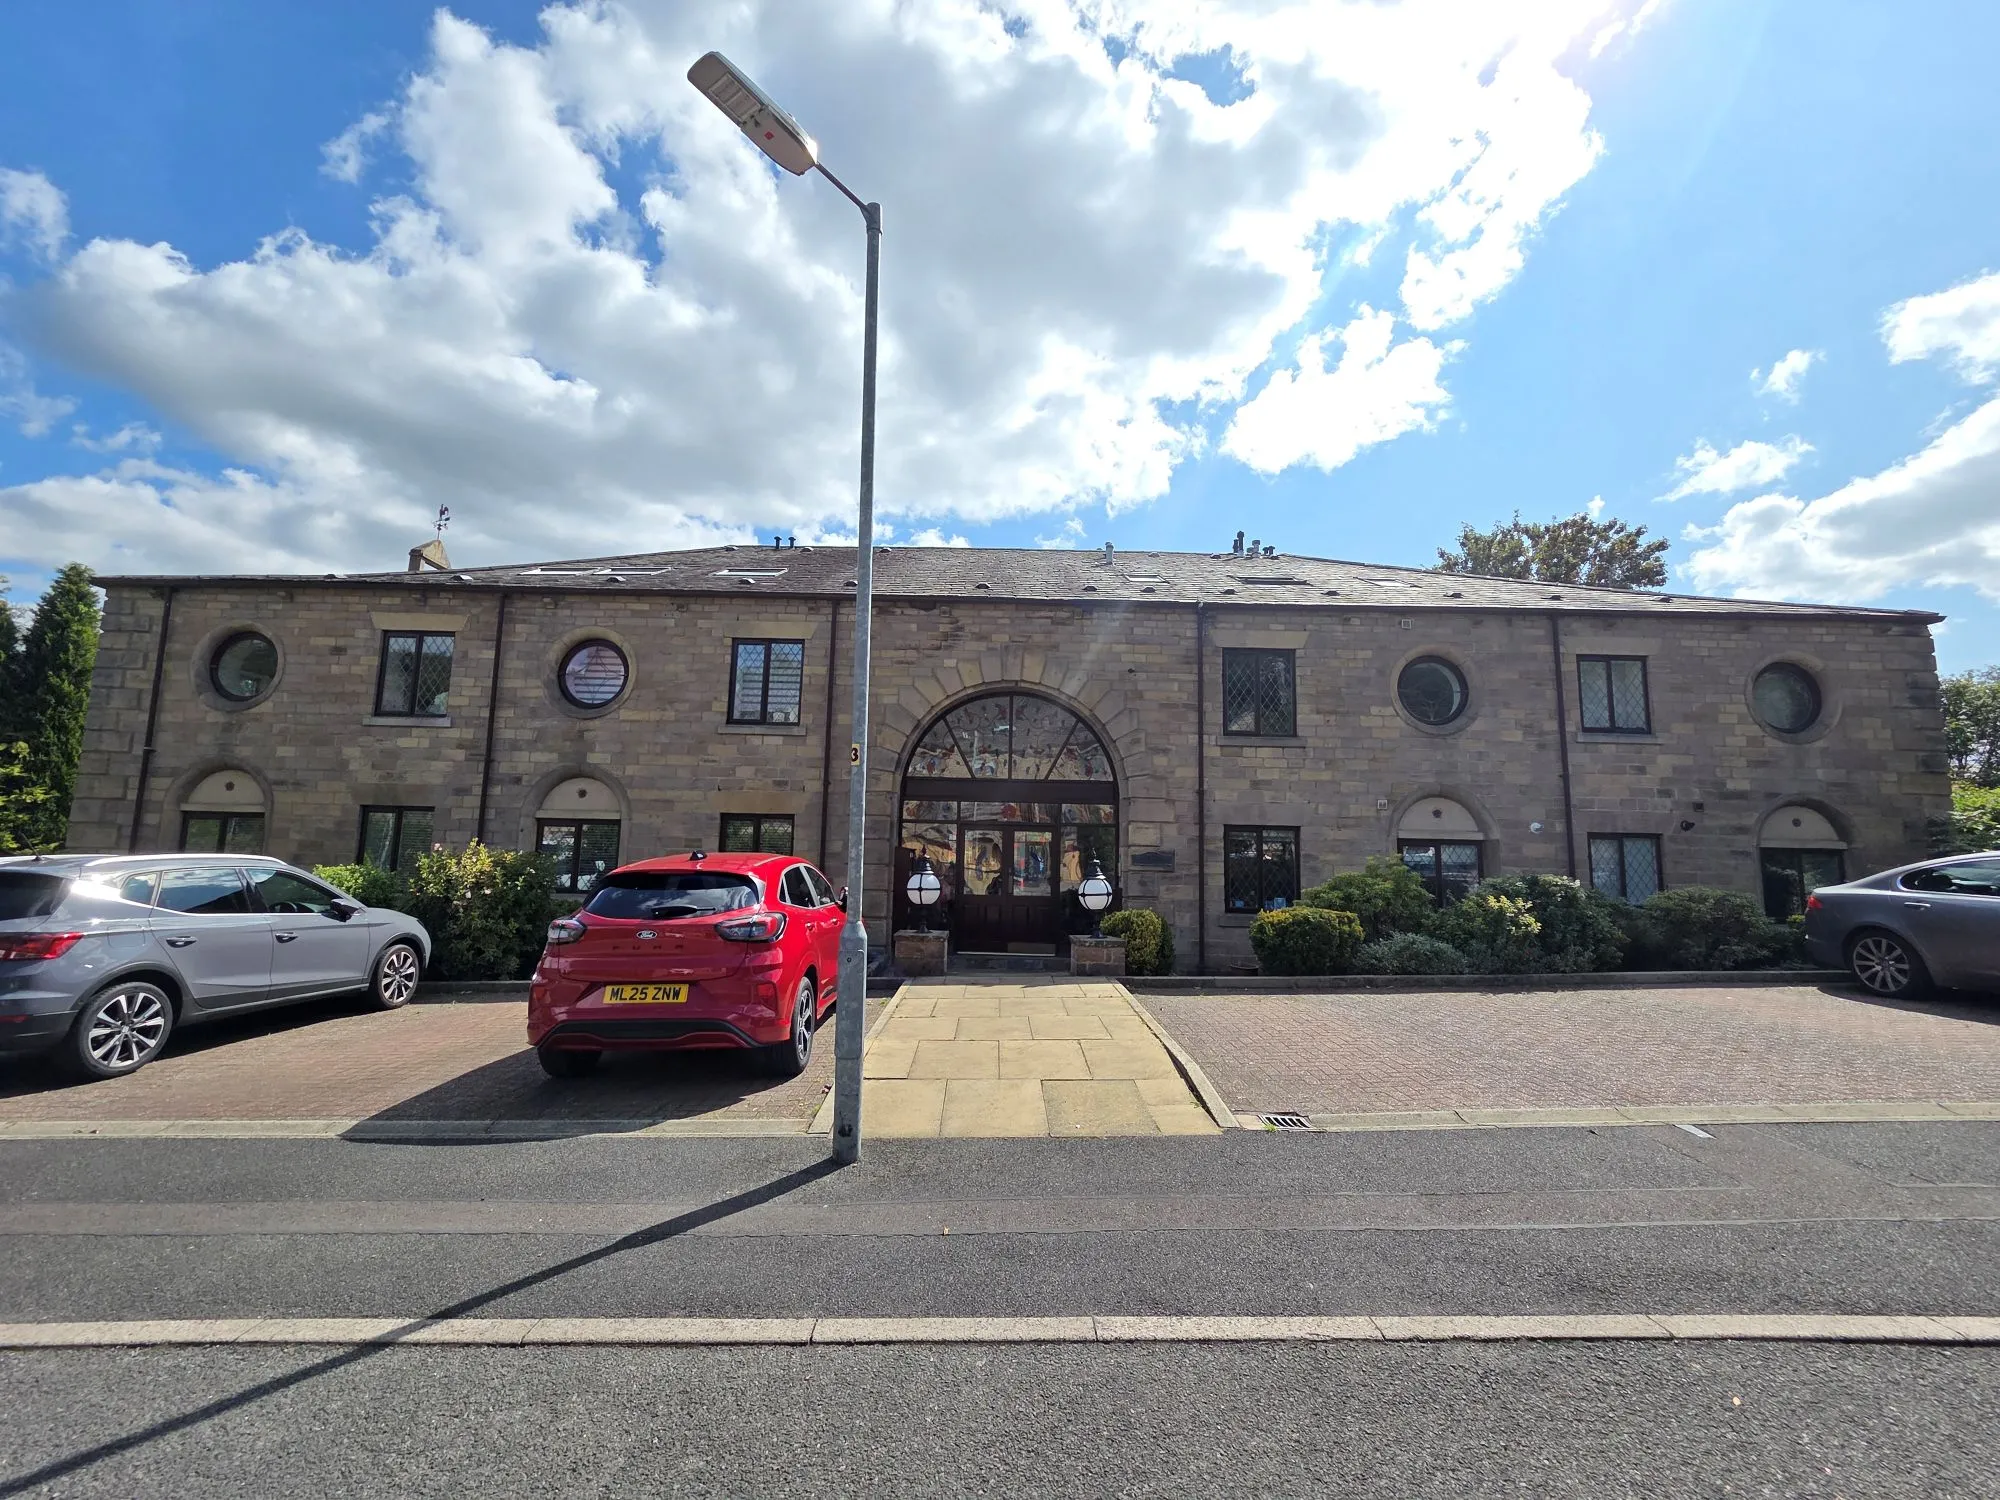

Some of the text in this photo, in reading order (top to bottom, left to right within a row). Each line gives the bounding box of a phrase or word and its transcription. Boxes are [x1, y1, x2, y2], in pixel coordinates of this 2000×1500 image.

[851, 748, 858, 762] 3
[609, 987, 681, 1000] ML25 ZNW
